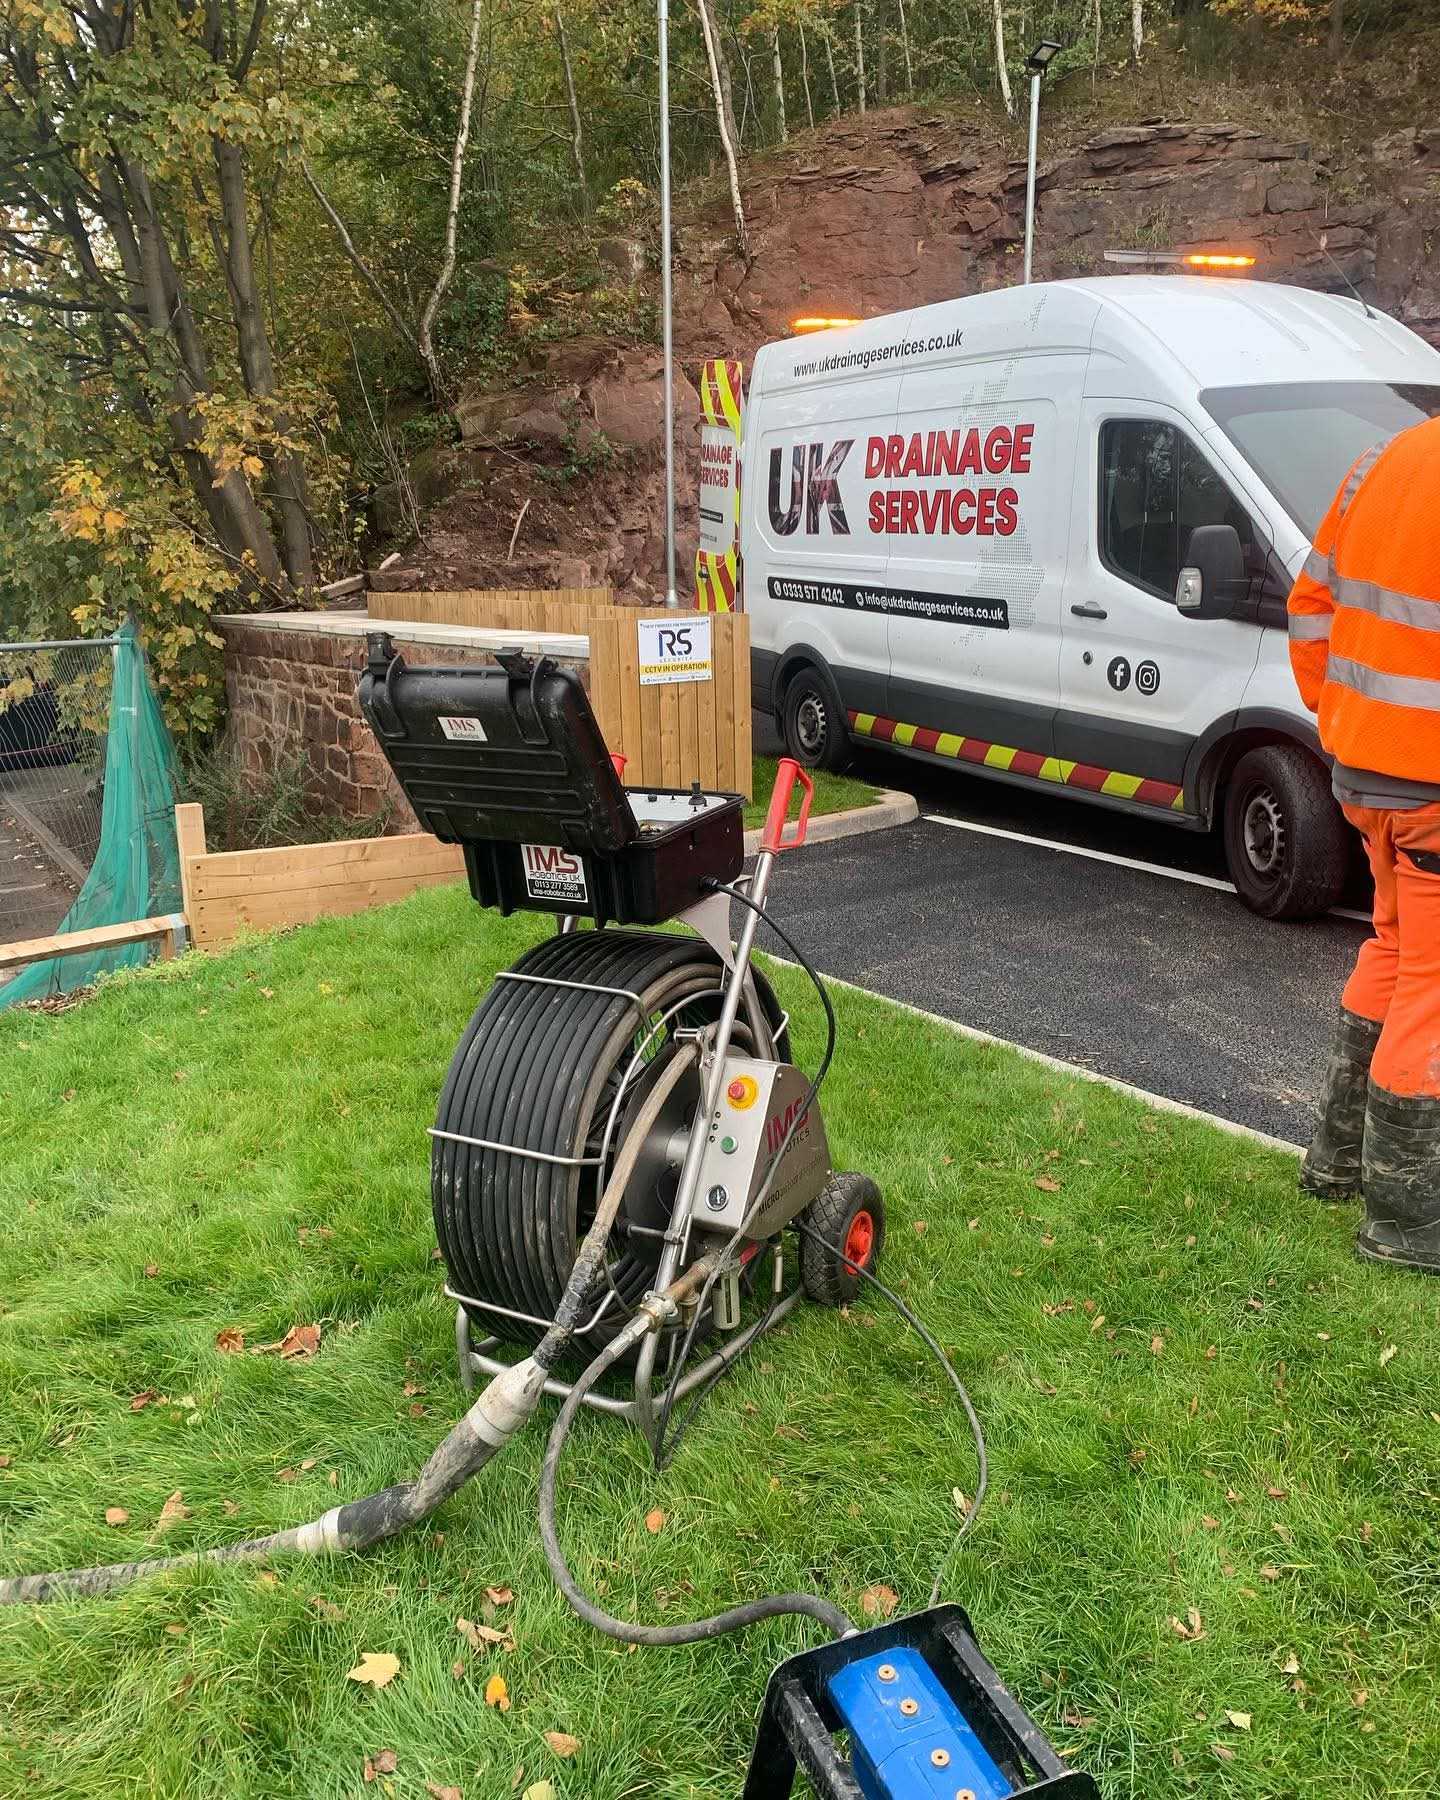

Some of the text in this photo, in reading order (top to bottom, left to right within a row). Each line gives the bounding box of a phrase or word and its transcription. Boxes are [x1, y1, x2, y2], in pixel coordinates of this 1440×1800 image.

[793, 329, 963, 377] www.ukdrainageservices.co.uk
[702, 444, 733, 465] RAINAGE
[864, 423, 1035, 479] DRAINAGE
[768, 438, 856, 537] UK
[868, 487, 1019, 536] SERVICES
[783, 582, 845, 604] 0333 577 4242
[864, 591, 1004, 622] info@ukdrainageservices.co.uk
[658, 628, 692, 657] RS
[644, 662, 708, 674] CCTV IN OPERATION
[447, 719, 476, 731] IMS
[526, 846, 578, 874] IMS
[529, 871, 581, 882] ROBOTICS UK
[534, 881, 550, 889] 0113
[550, 881, 562, 890] 277
[766, 1097, 810, 1155] IMS
[767, 1127, 810, 1169] ROTICS
[758, 1190, 780, 1217] MICRO
